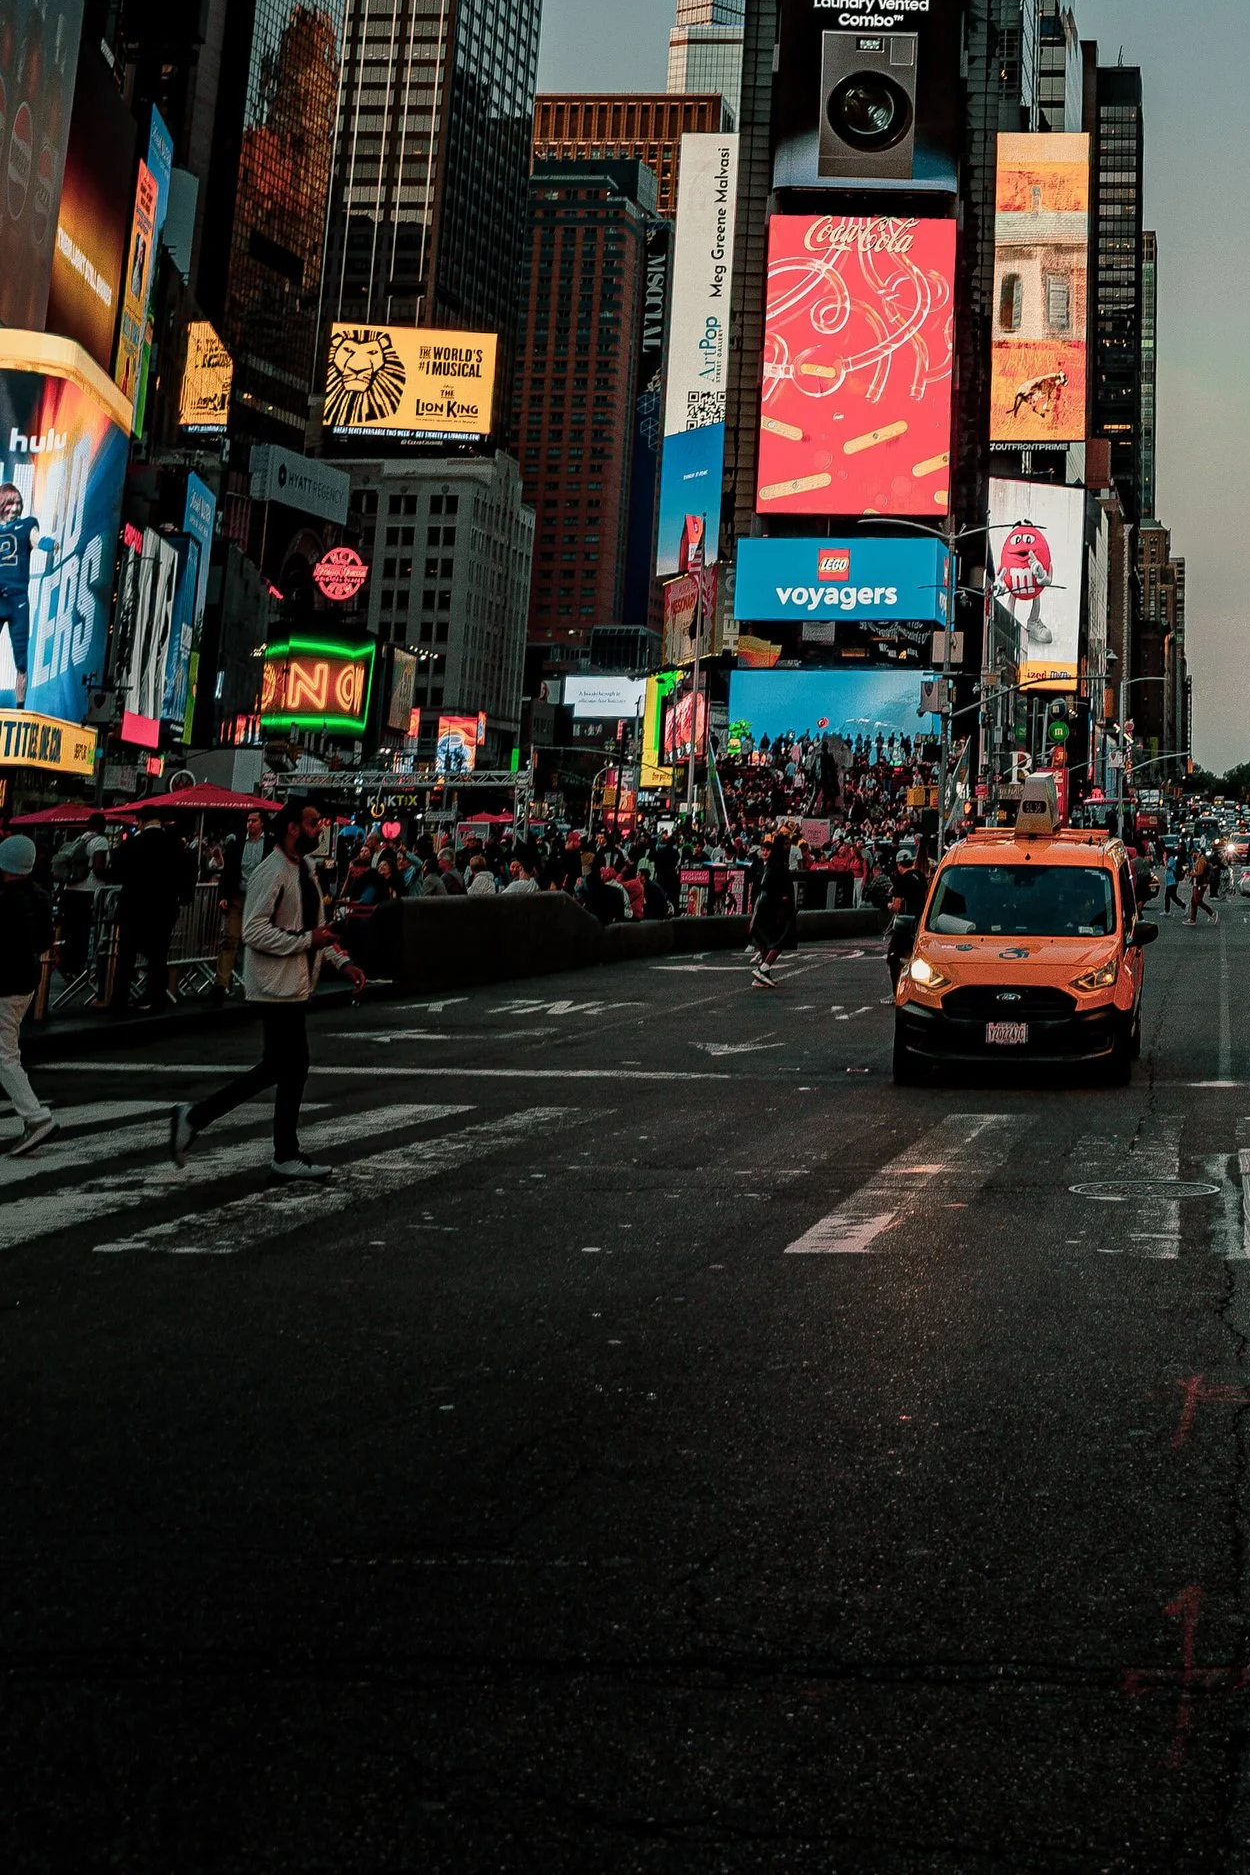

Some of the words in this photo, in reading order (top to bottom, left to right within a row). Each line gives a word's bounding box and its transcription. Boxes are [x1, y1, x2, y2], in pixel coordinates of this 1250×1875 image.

[714, 146, 731, 204] Malvasi
[711, 206, 729, 259] Greene
[708, 263, 728, 299] Meg
[433, 346, 484, 364] WORLD'S
[698, 315, 719, 383] ArtPop
[431, 362, 483, 379] MUSICAL
[415, 399, 444, 416] LION
[446, 400, 479, 418] KING
[9, 427, 68, 454] hulu
[819, 556, 850, 572] LEGO
[775, 586, 898, 611] voyagers
